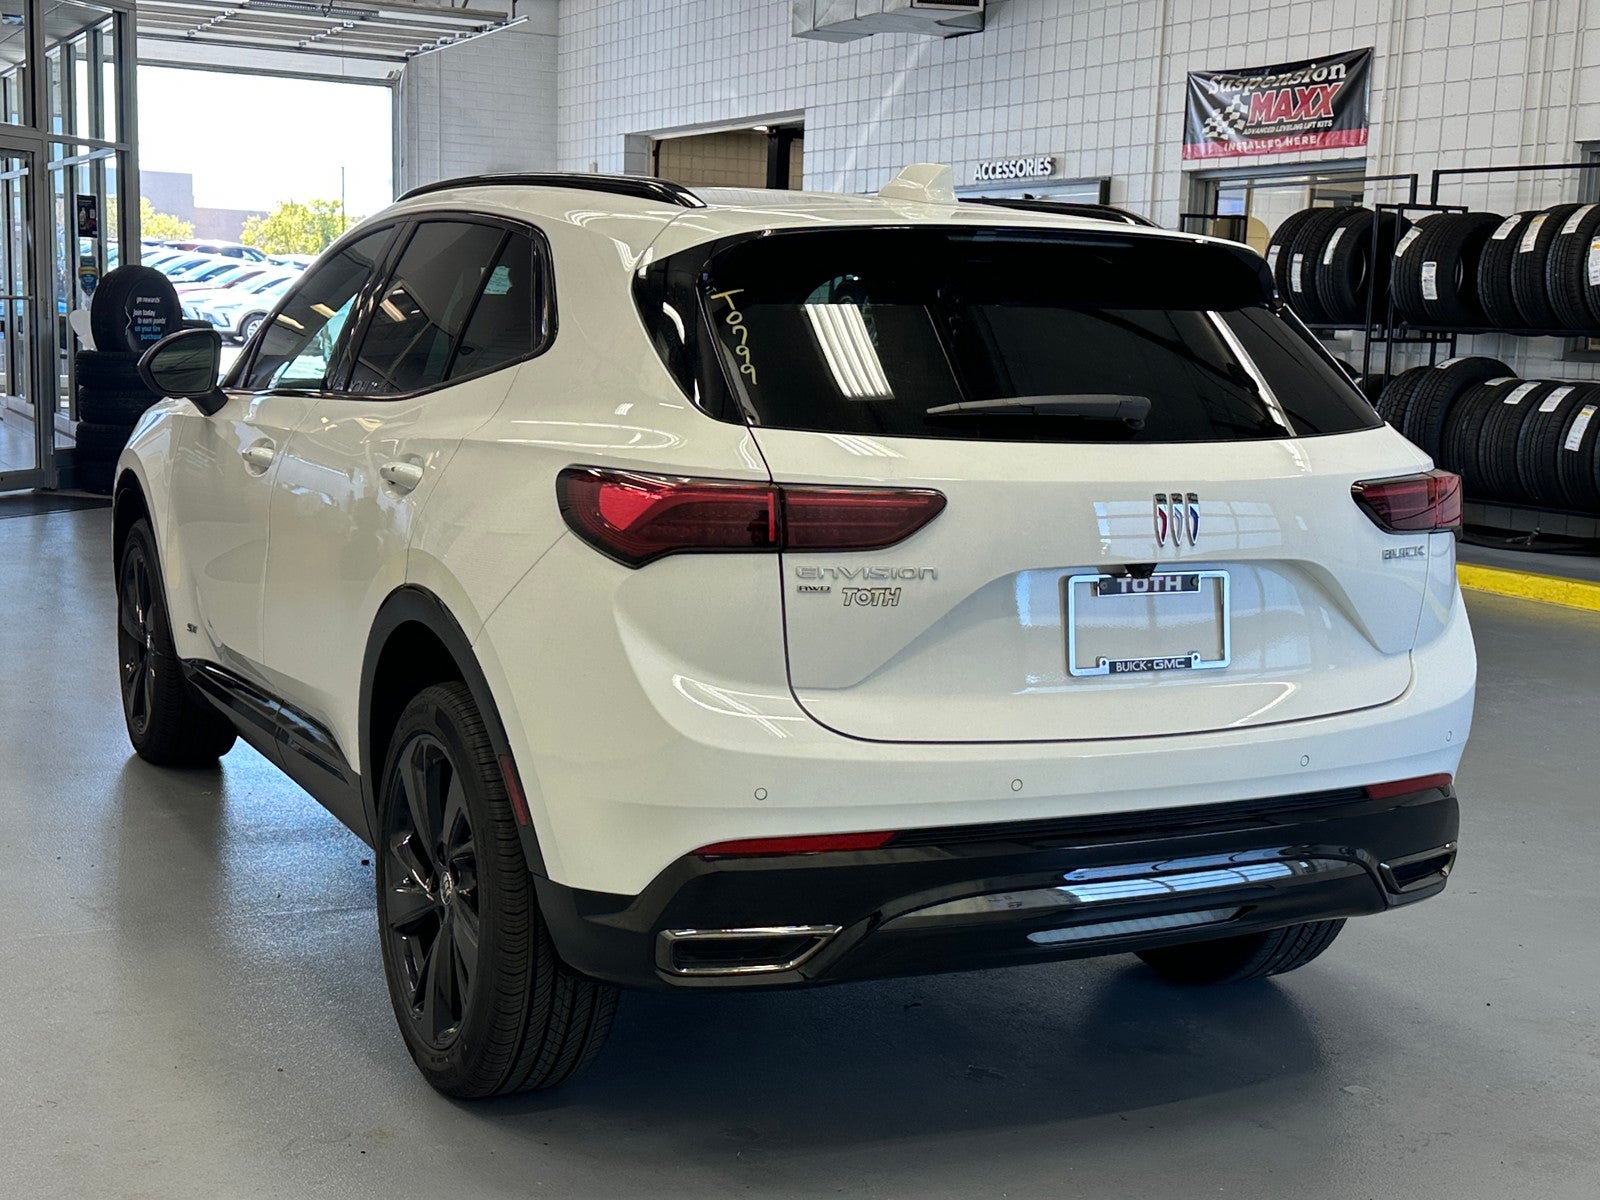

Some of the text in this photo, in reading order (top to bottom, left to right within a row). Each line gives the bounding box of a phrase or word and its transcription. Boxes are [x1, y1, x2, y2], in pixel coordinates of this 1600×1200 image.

[1208, 63, 1347, 96] Suspension
[1246, 81, 1344, 126] MAXX
[1242, 120, 1333, 135] ADVANCED LEVELING LIFT KITS
[1224, 135, 1317, 151] INSTALLED HERE
[973, 157, 1052, 181] ACCESSORIES
[142, 309, 155, 317] today
[1382, 545, 1425, 560] BUICK
[795, 565, 939, 581] ENVISION
[798, 584, 831, 593] AWD
[1117, 576, 1182, 593] TOTH
[842, 587, 902, 607] TOTH
